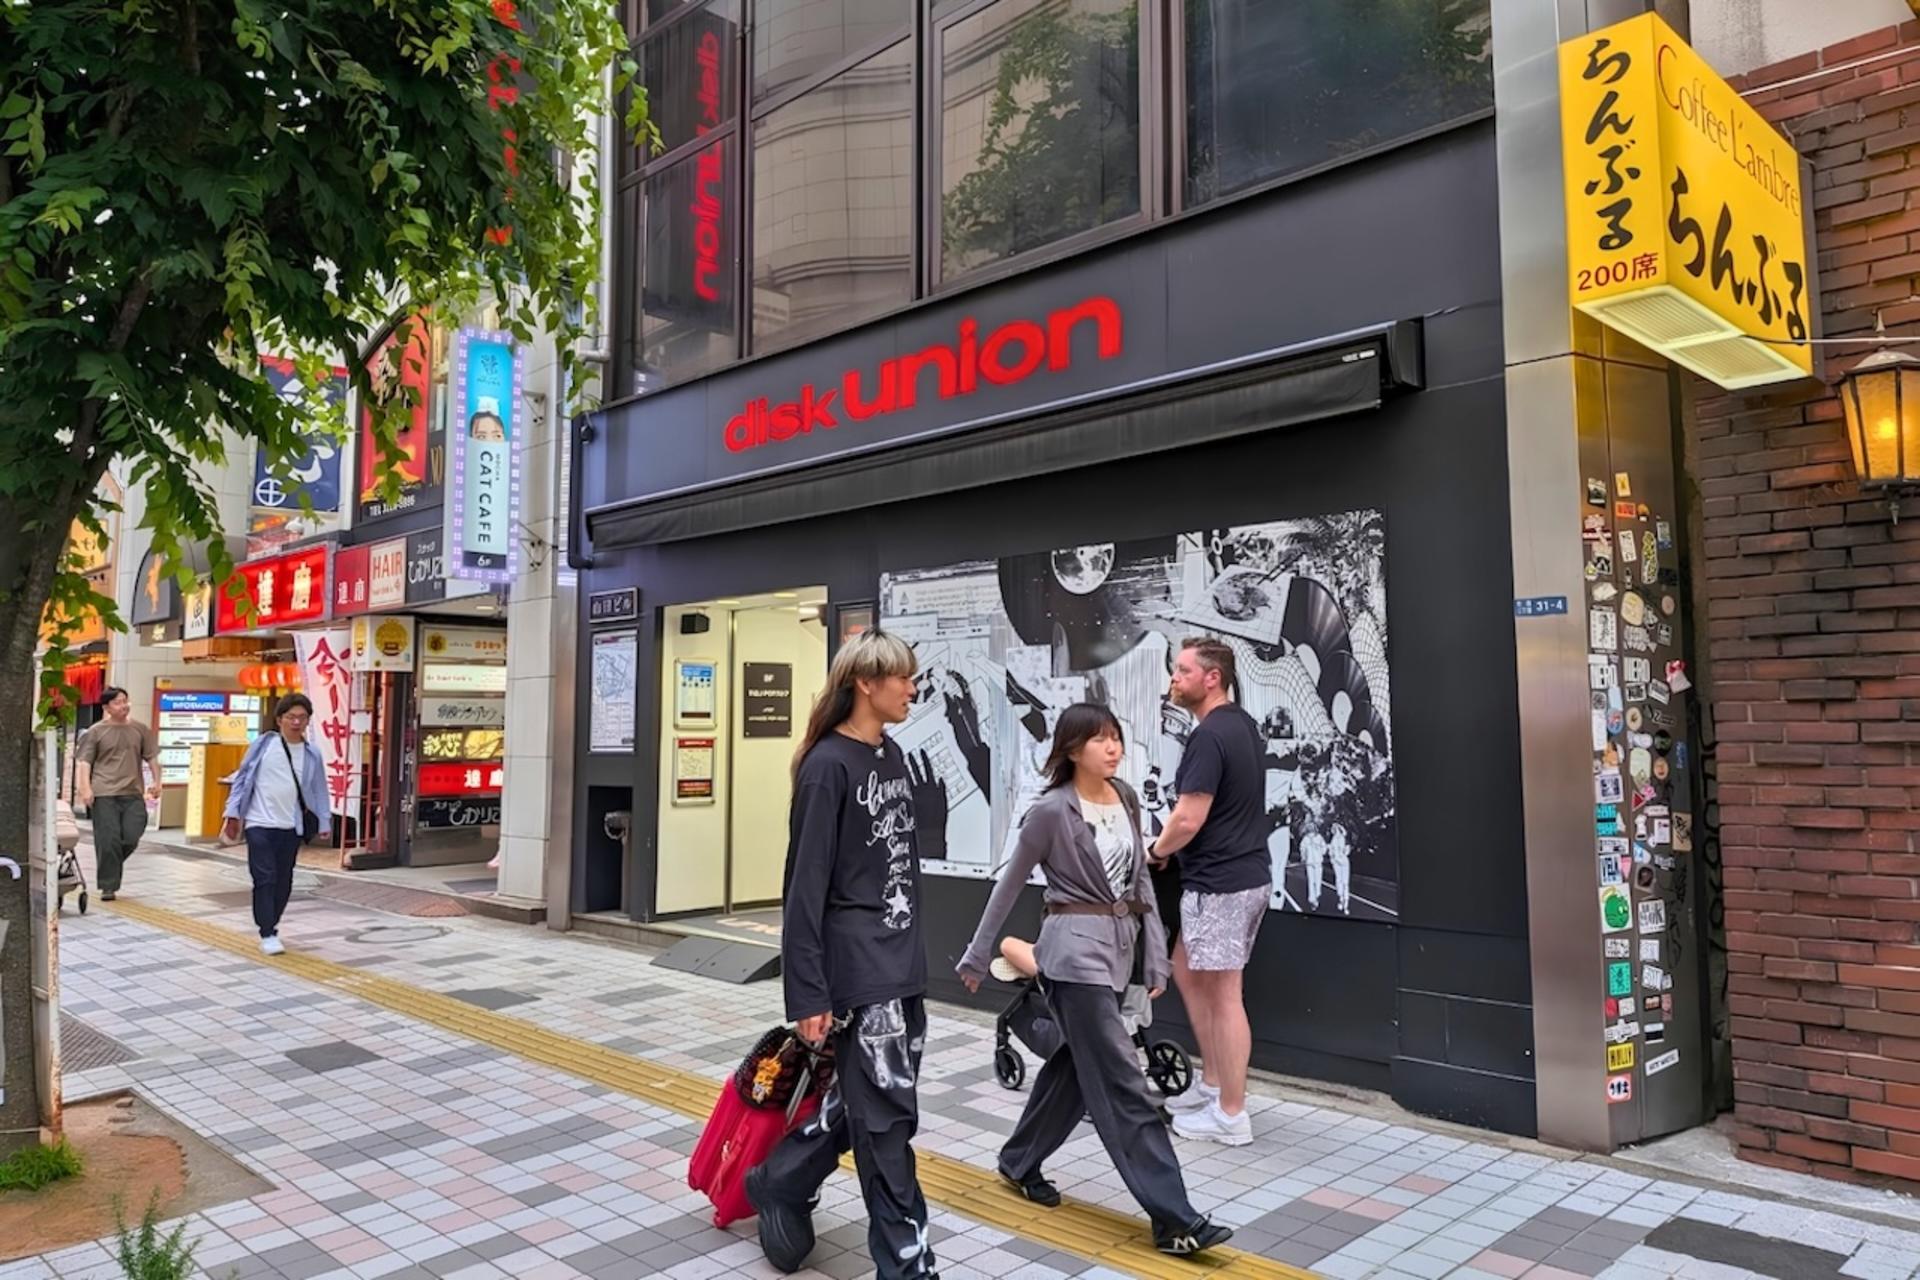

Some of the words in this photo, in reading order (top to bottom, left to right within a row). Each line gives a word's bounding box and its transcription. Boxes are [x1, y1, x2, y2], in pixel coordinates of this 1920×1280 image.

[1582, 38, 1640, 251] らんぶる
[1657, 44, 1728, 153] Coffee
[1730, 109, 1800, 217] L'ambre
[1577, 252, 1659, 291] 200席
[1668, 165, 1806, 346] らんぶる
[723, 384, 838, 453] disk
[842, 296, 1122, 421] union
[479, 450, 493, 489] CAT
[477, 492, 492, 544] CAFE
[372, 551, 403, 580] HAIR
[1536, 599, 1563, 611] 31-4
